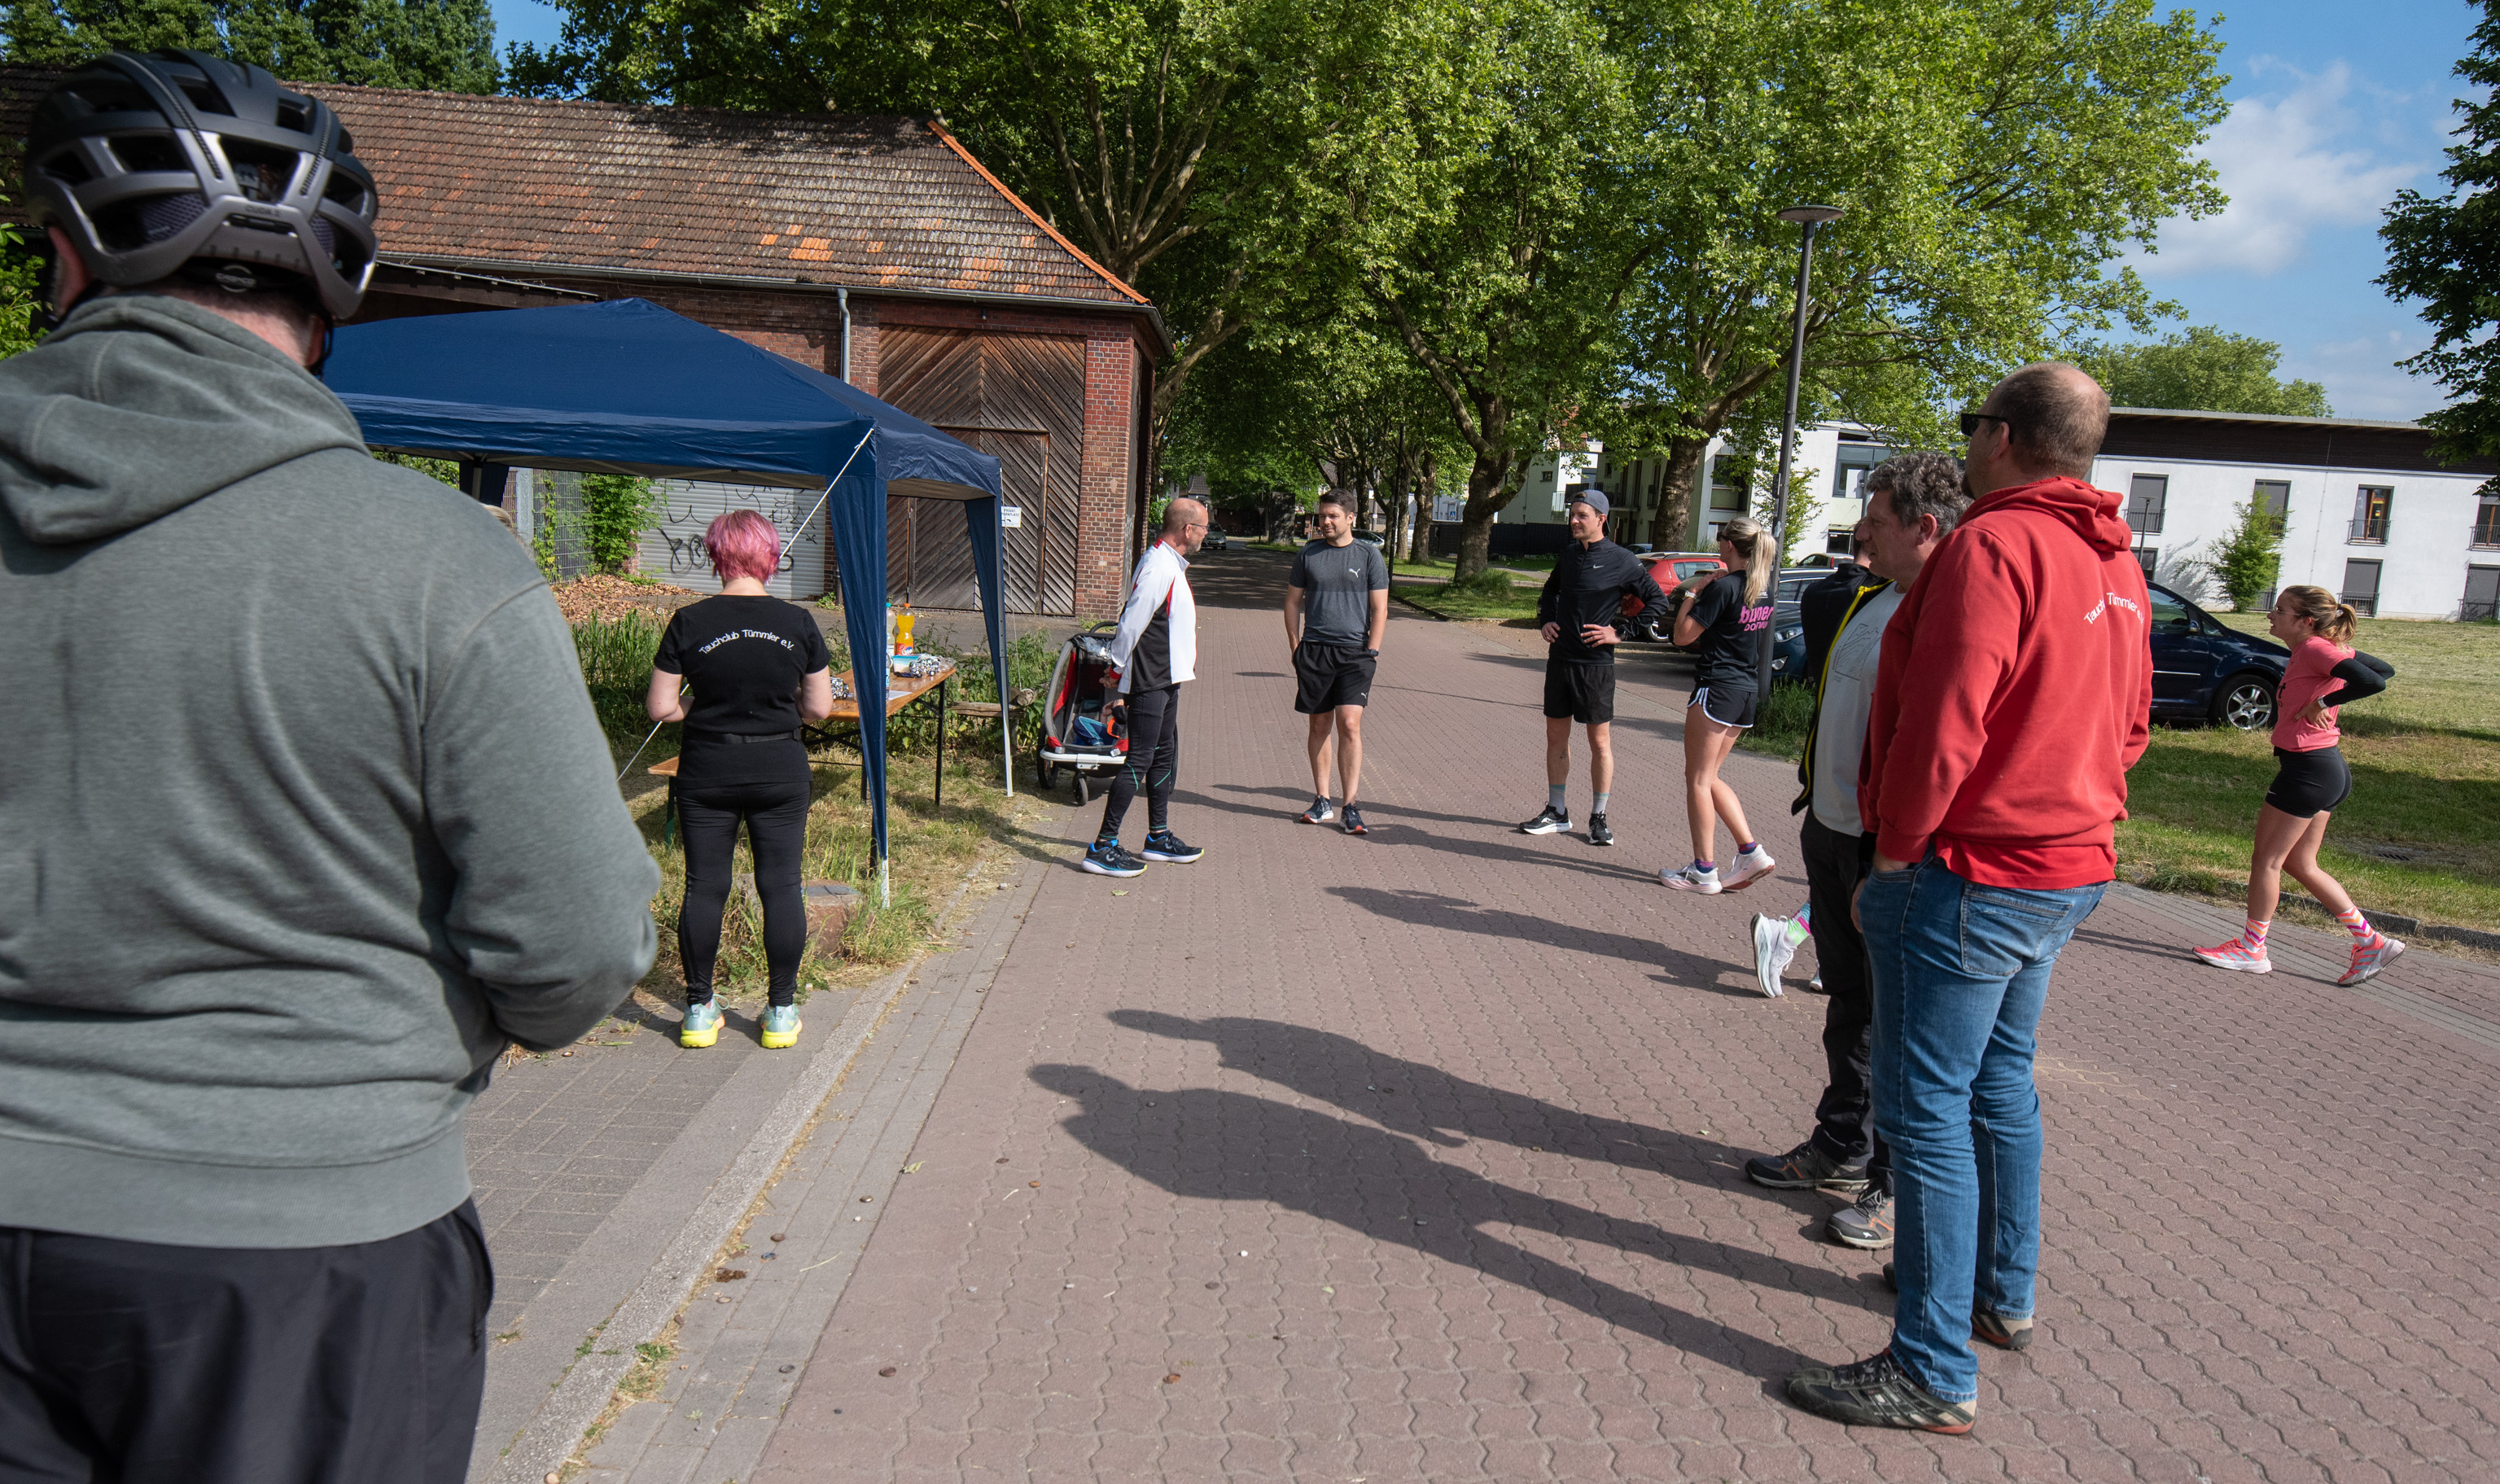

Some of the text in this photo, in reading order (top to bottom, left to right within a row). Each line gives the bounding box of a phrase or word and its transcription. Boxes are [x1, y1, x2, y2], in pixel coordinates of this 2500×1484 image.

[2083, 599, 2105, 624] Tauch
[698, 628, 795, 654] Tauchclub Tümmler e.V.
